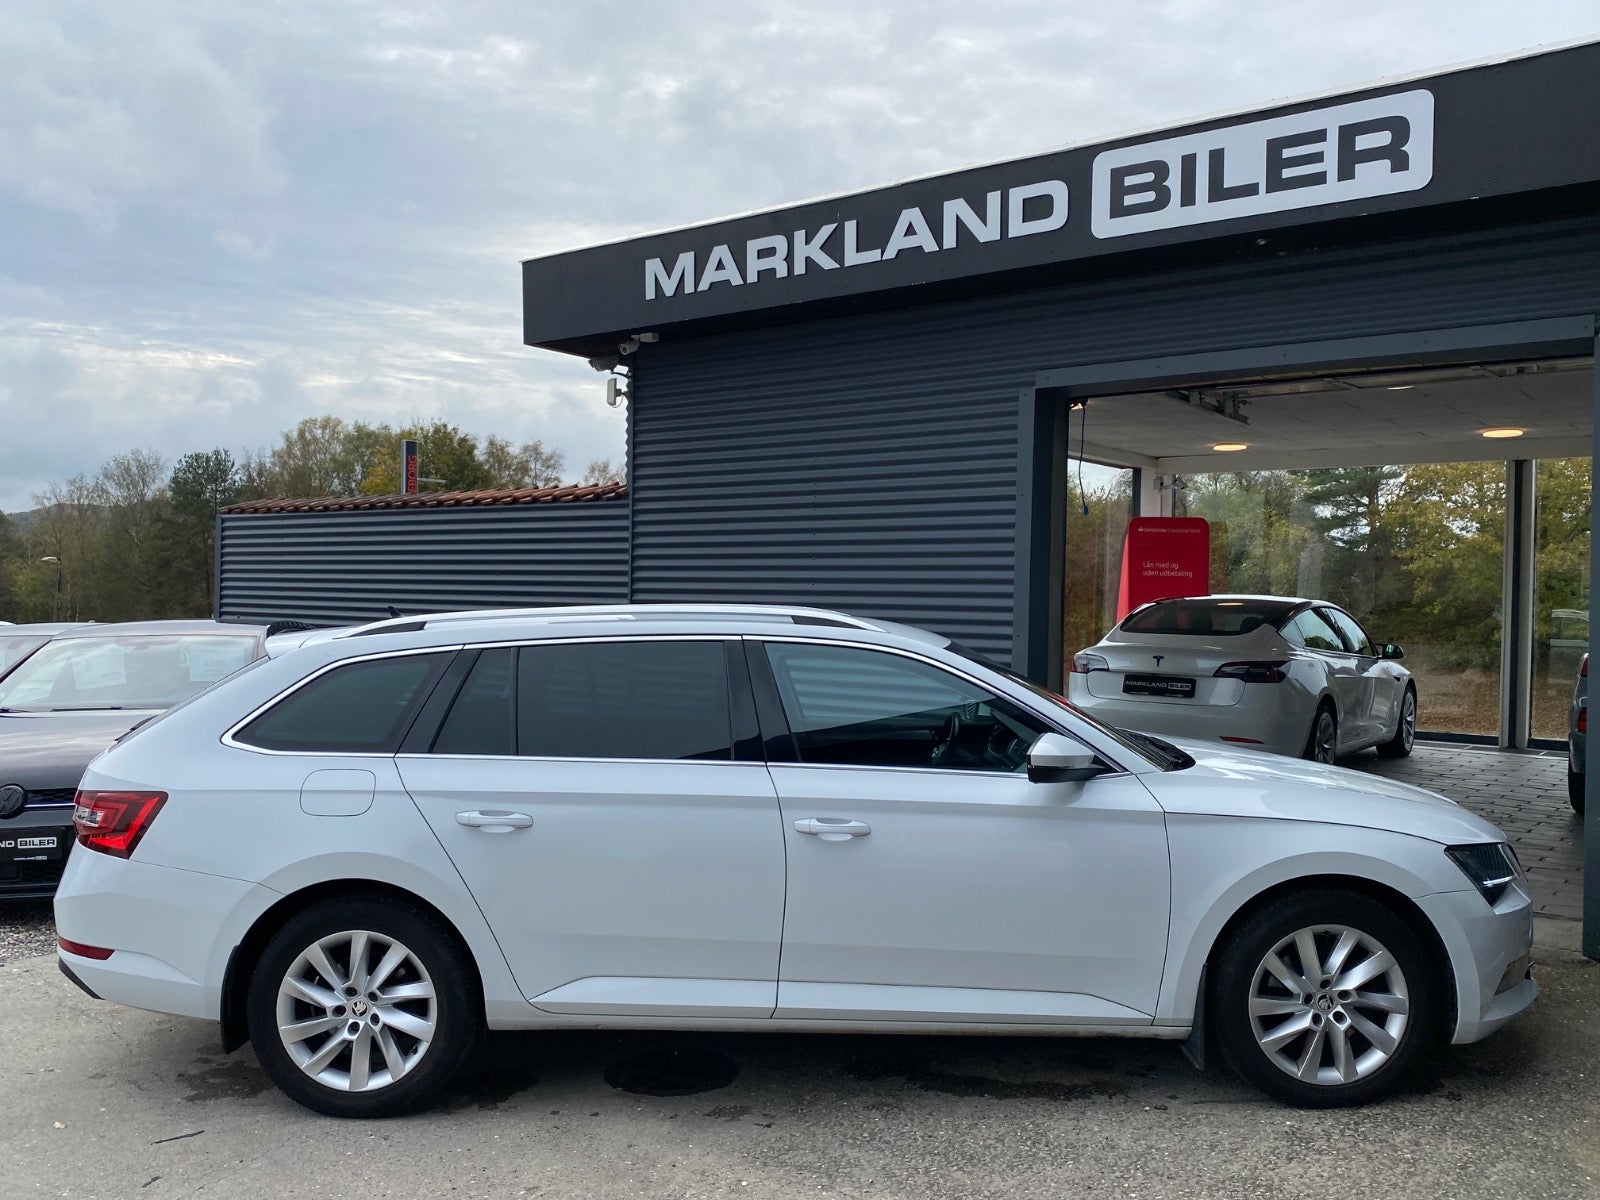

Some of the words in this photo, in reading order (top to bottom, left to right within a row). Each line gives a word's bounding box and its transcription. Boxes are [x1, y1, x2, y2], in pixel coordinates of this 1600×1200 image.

[643, 179, 1070, 301] MARKLAND
[1107, 114, 1413, 219] BILER
[1155, 561, 1169, 569] med
[1170, 562, 1179, 570] og
[1125, 680, 1167, 688] MARKLAND
[18, 838, 56, 847] BILER
